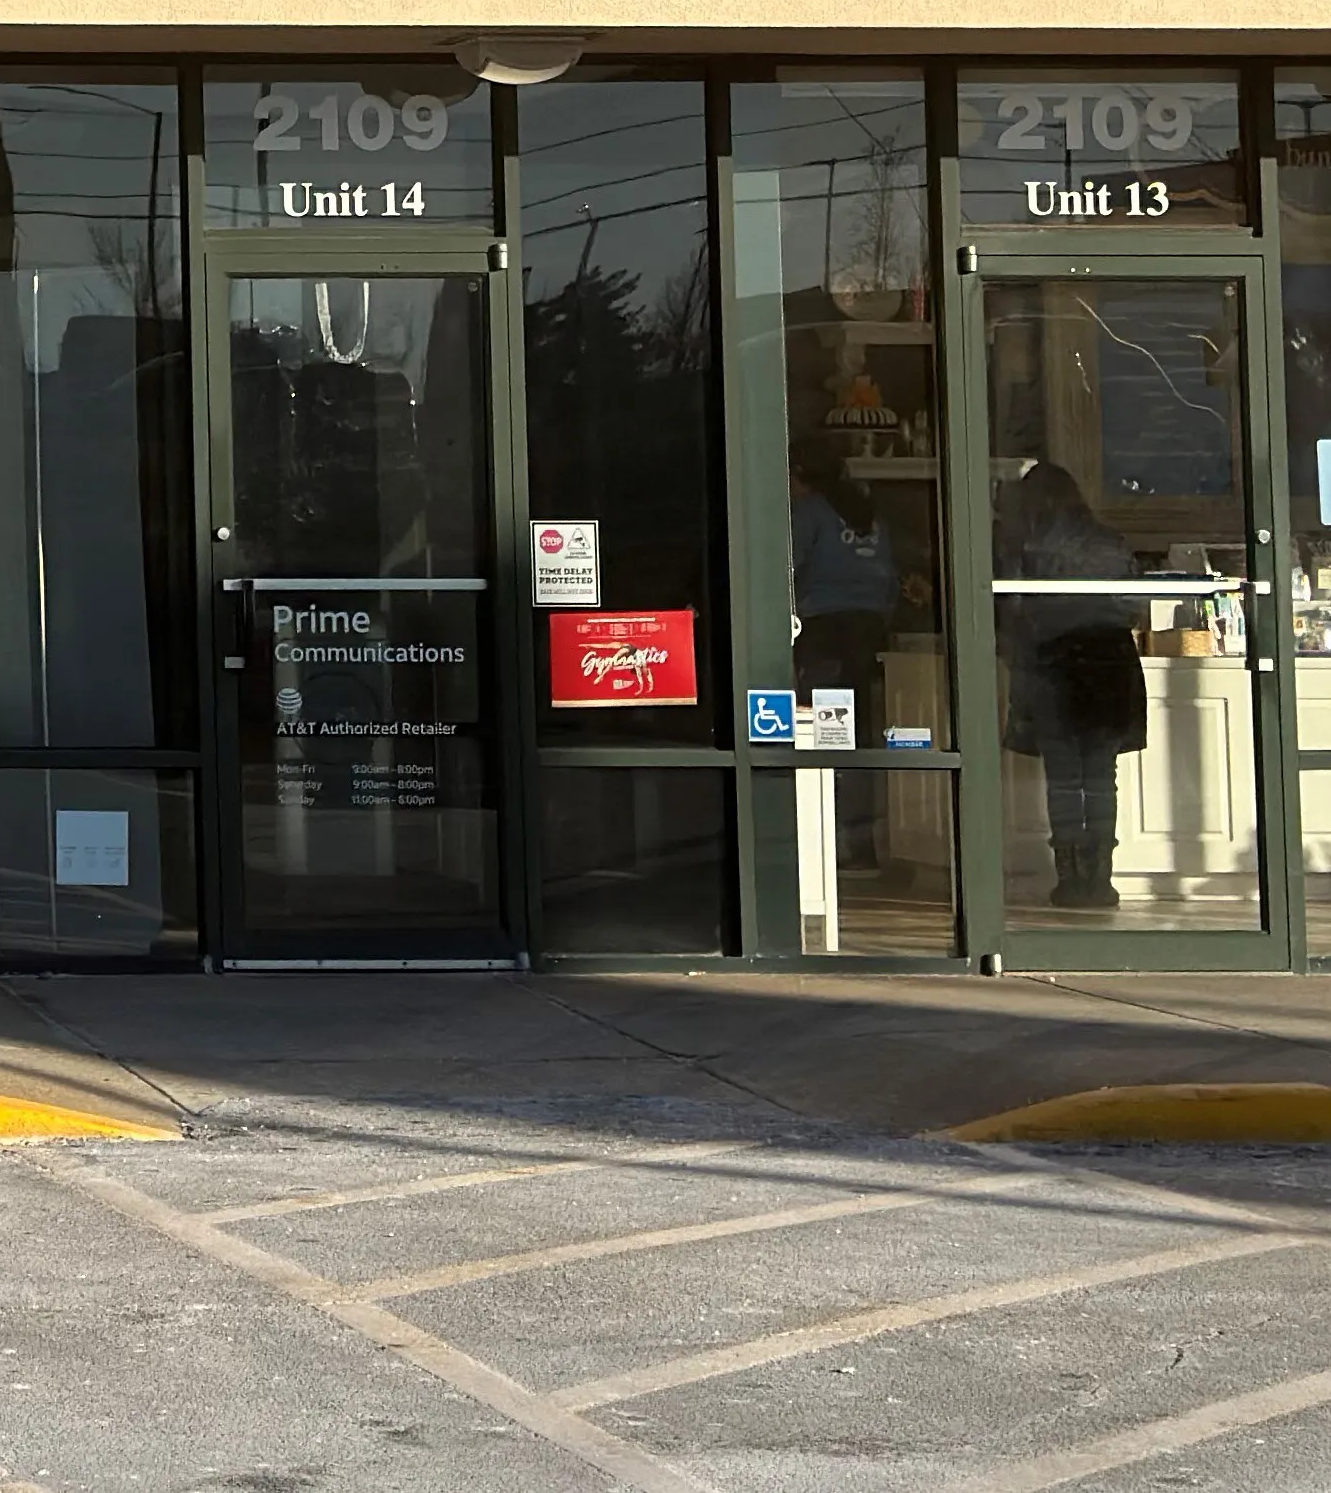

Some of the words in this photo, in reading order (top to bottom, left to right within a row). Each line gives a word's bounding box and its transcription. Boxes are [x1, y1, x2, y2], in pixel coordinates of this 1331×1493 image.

[253, 94, 449, 151] 2109
[997, 93, 1193, 151] 2109
[279, 182, 368, 217] Unit
[380, 182, 425, 217] 14
[1024, 181, 1113, 216] Unit
[1125, 181, 1170, 216] 13
[541, 537, 562, 547] STOP
[273, 604, 370, 634] Prime
[274, 643, 465, 663] Communications
[276, 722, 316, 735] AT&T
[320, 721, 398, 735] Authorized
[402, 722, 456, 735] Retailer
